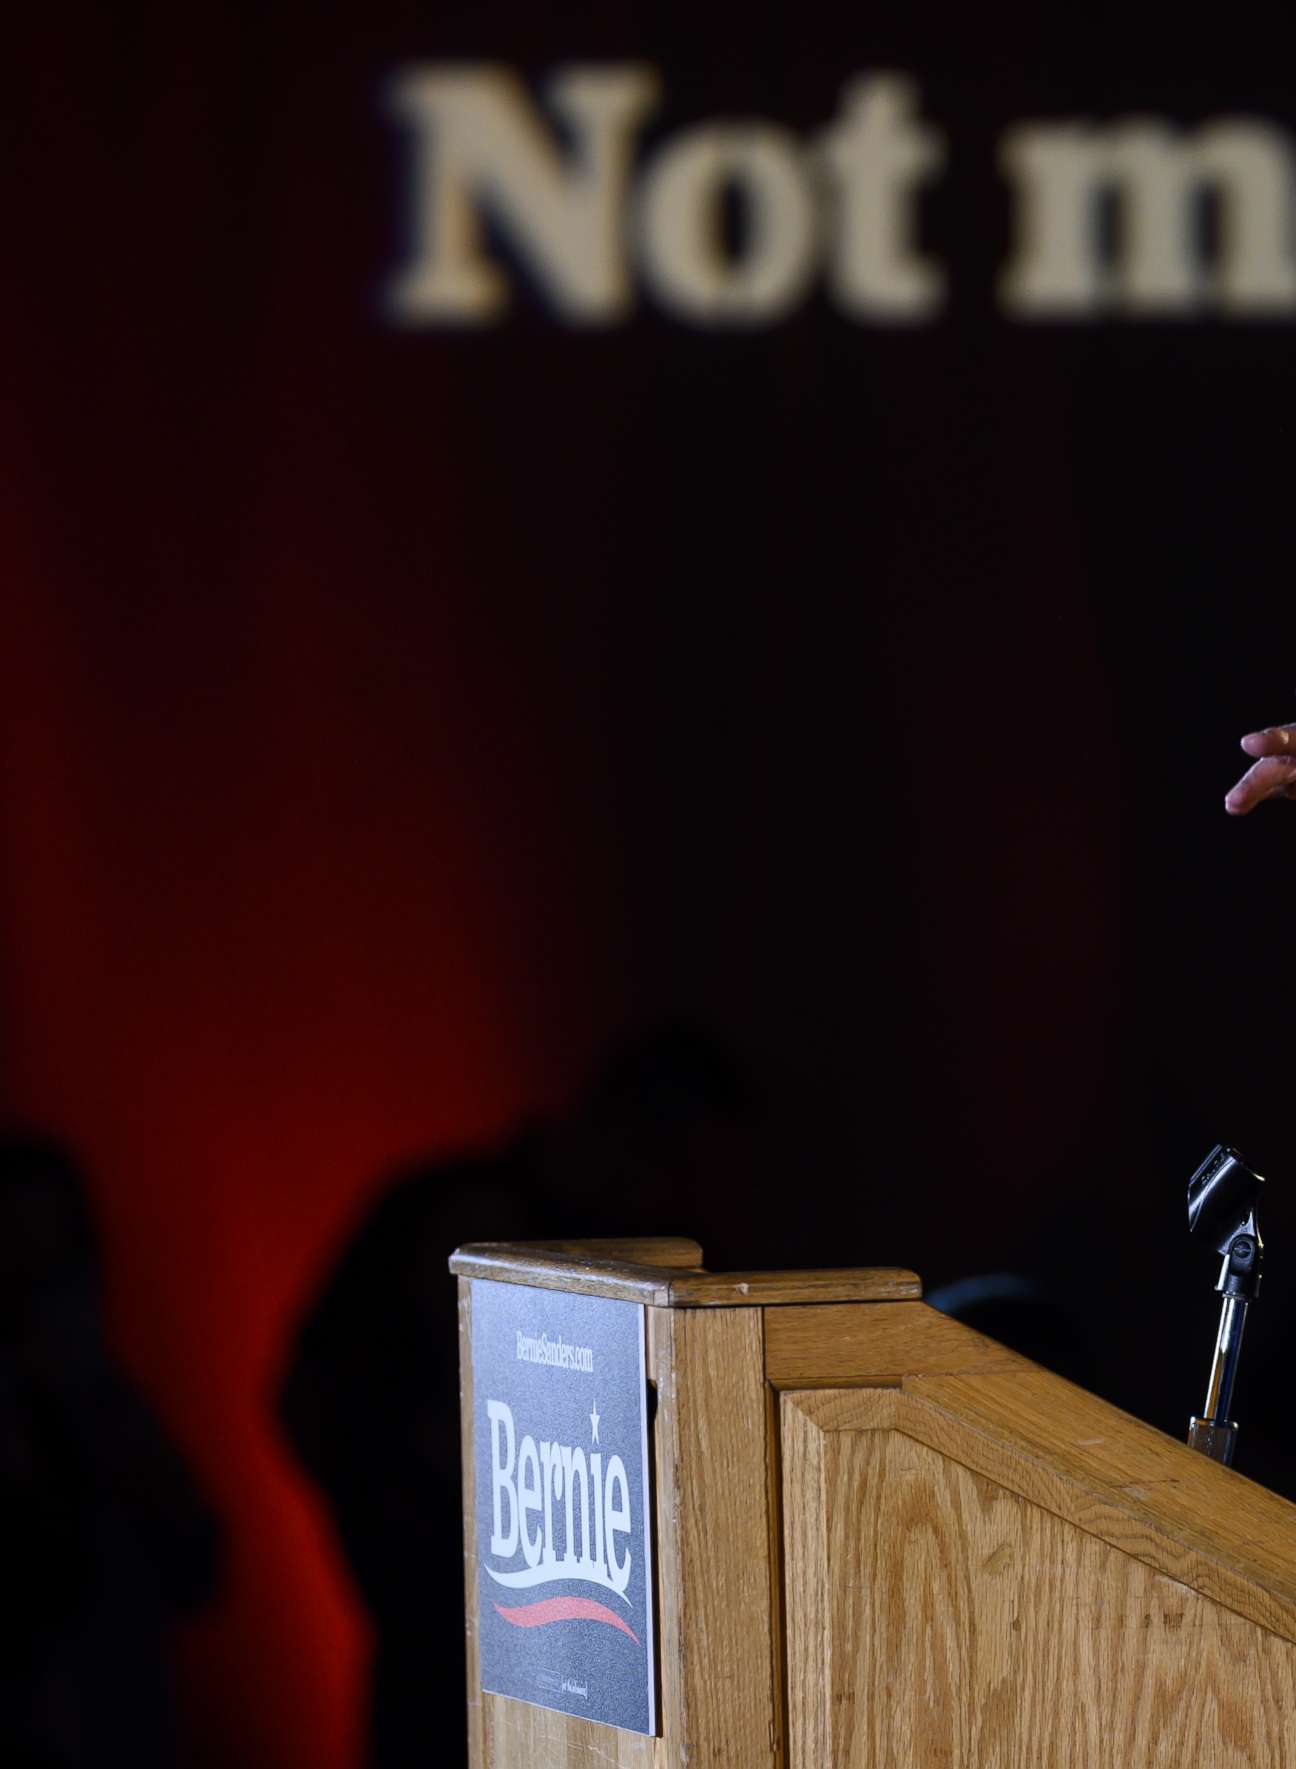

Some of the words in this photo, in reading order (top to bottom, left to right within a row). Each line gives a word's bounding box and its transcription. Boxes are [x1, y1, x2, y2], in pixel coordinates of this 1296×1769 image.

[400, 70, 939, 318] Not
[516, 1331, 593, 1373] BernieSanders.com
[487, 1399, 632, 1594] Bernie
